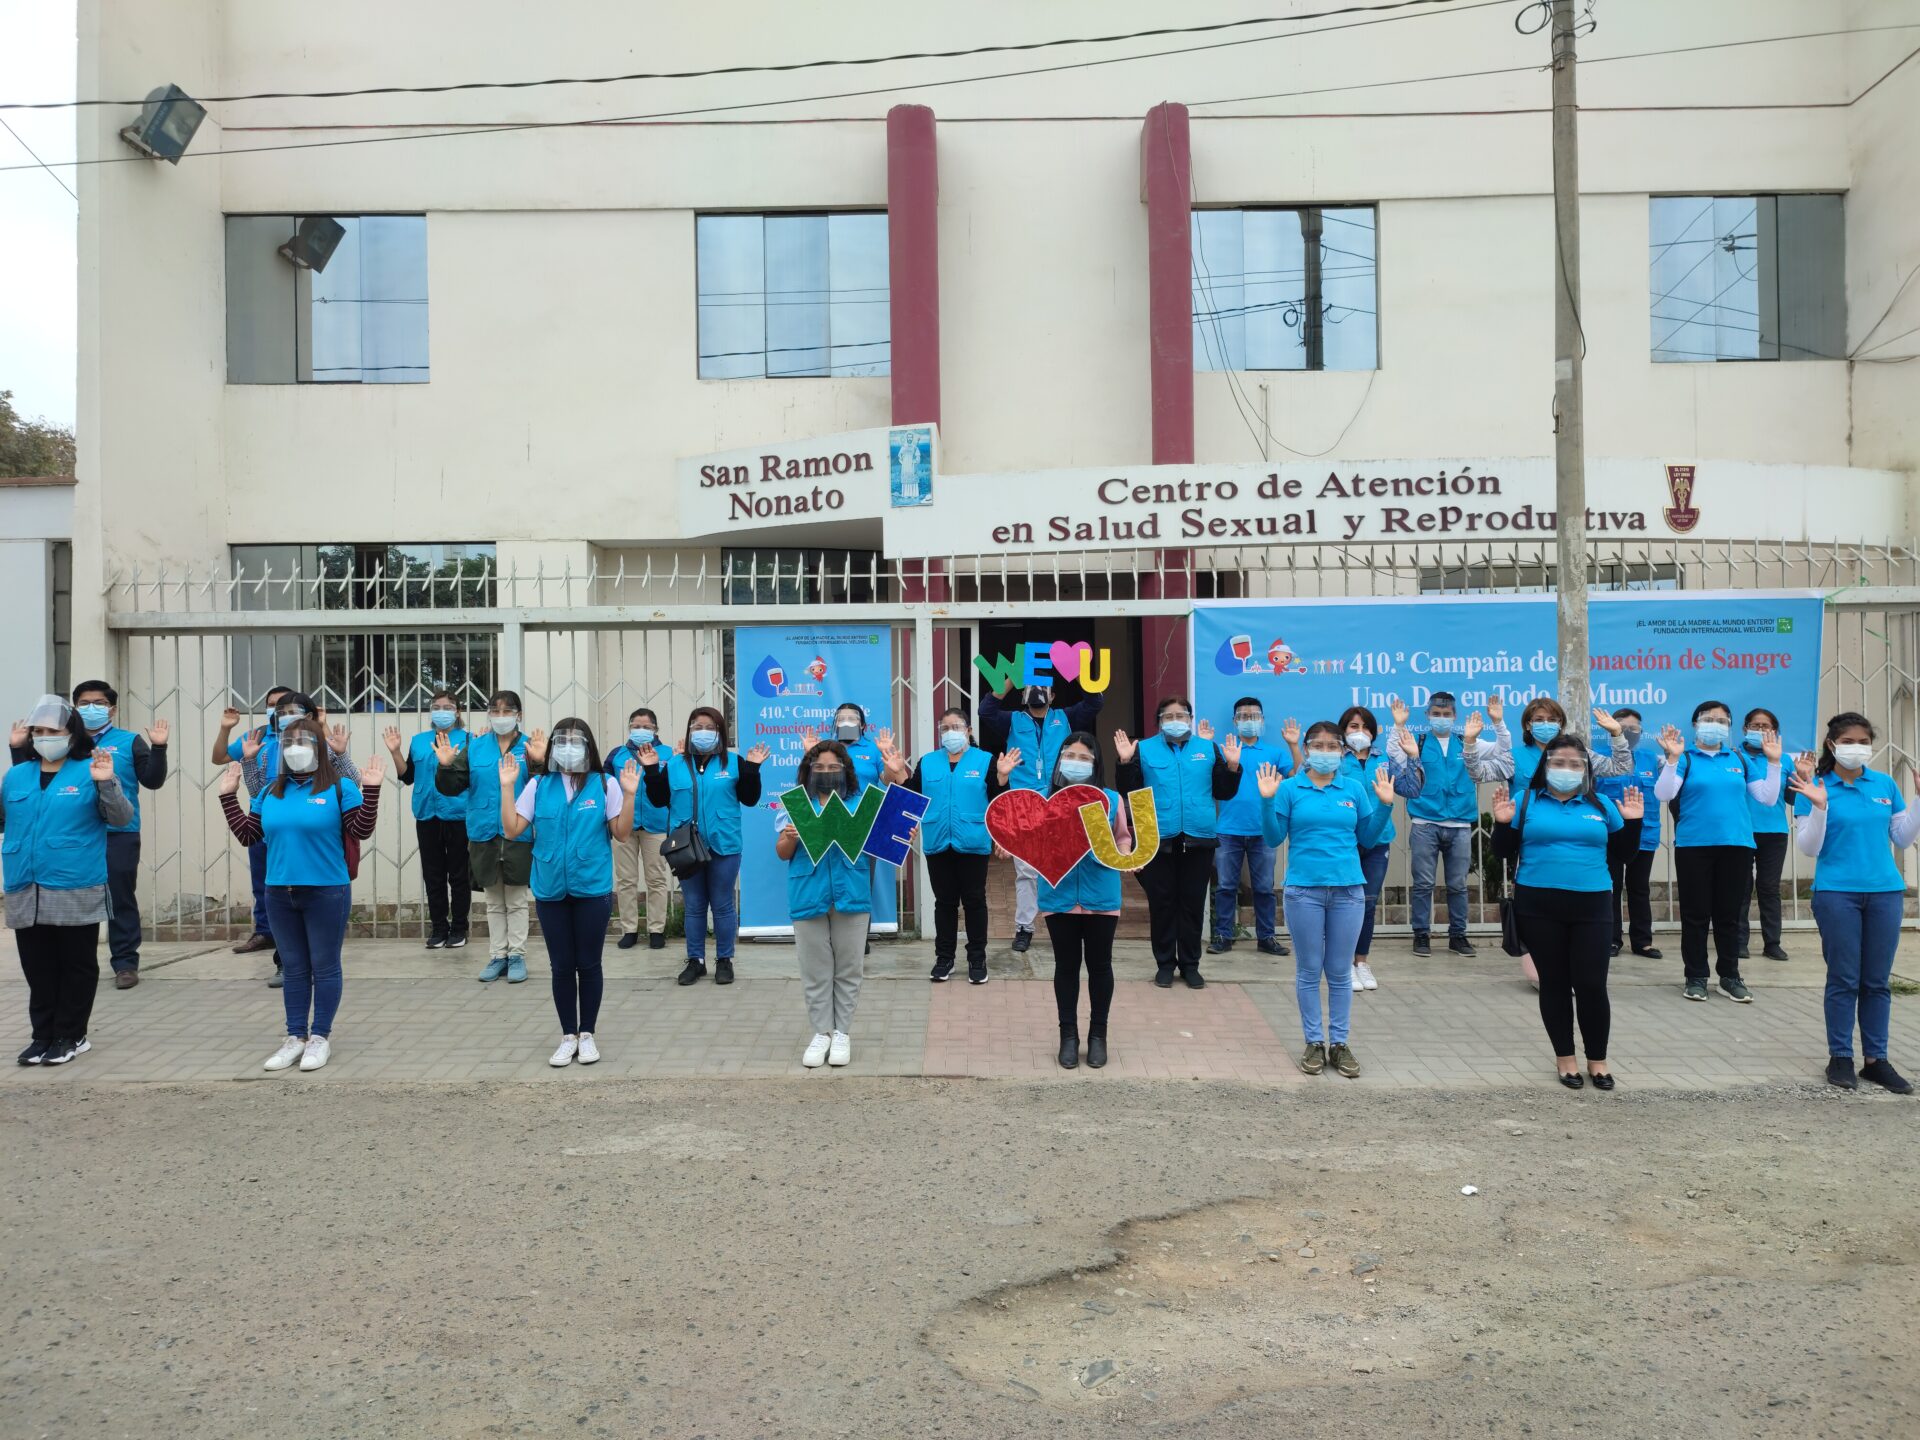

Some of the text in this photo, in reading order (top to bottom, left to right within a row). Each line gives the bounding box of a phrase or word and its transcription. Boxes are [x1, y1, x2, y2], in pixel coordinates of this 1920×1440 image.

[700, 452, 873, 488] San Ramon
[1097, 466, 1502, 505] Centro de Atención
[728, 486, 844, 520] Nonato
[992, 504, 1647, 544] en Salud Sexual y ReProdutiva
[1653, 625, 1690, 634] FUNDACIÓN
[1691, 626, 1743, 634] INTERNACIONAL
[1722, 618, 1746, 626] MUNDO
[1350, 647, 1793, 679] 410.ª Campaña de onación de Sangre
[1460, 691, 1488, 707] en
[1588, 682, 1668, 705] Mundo
[769, 753, 801, 767] Todo
